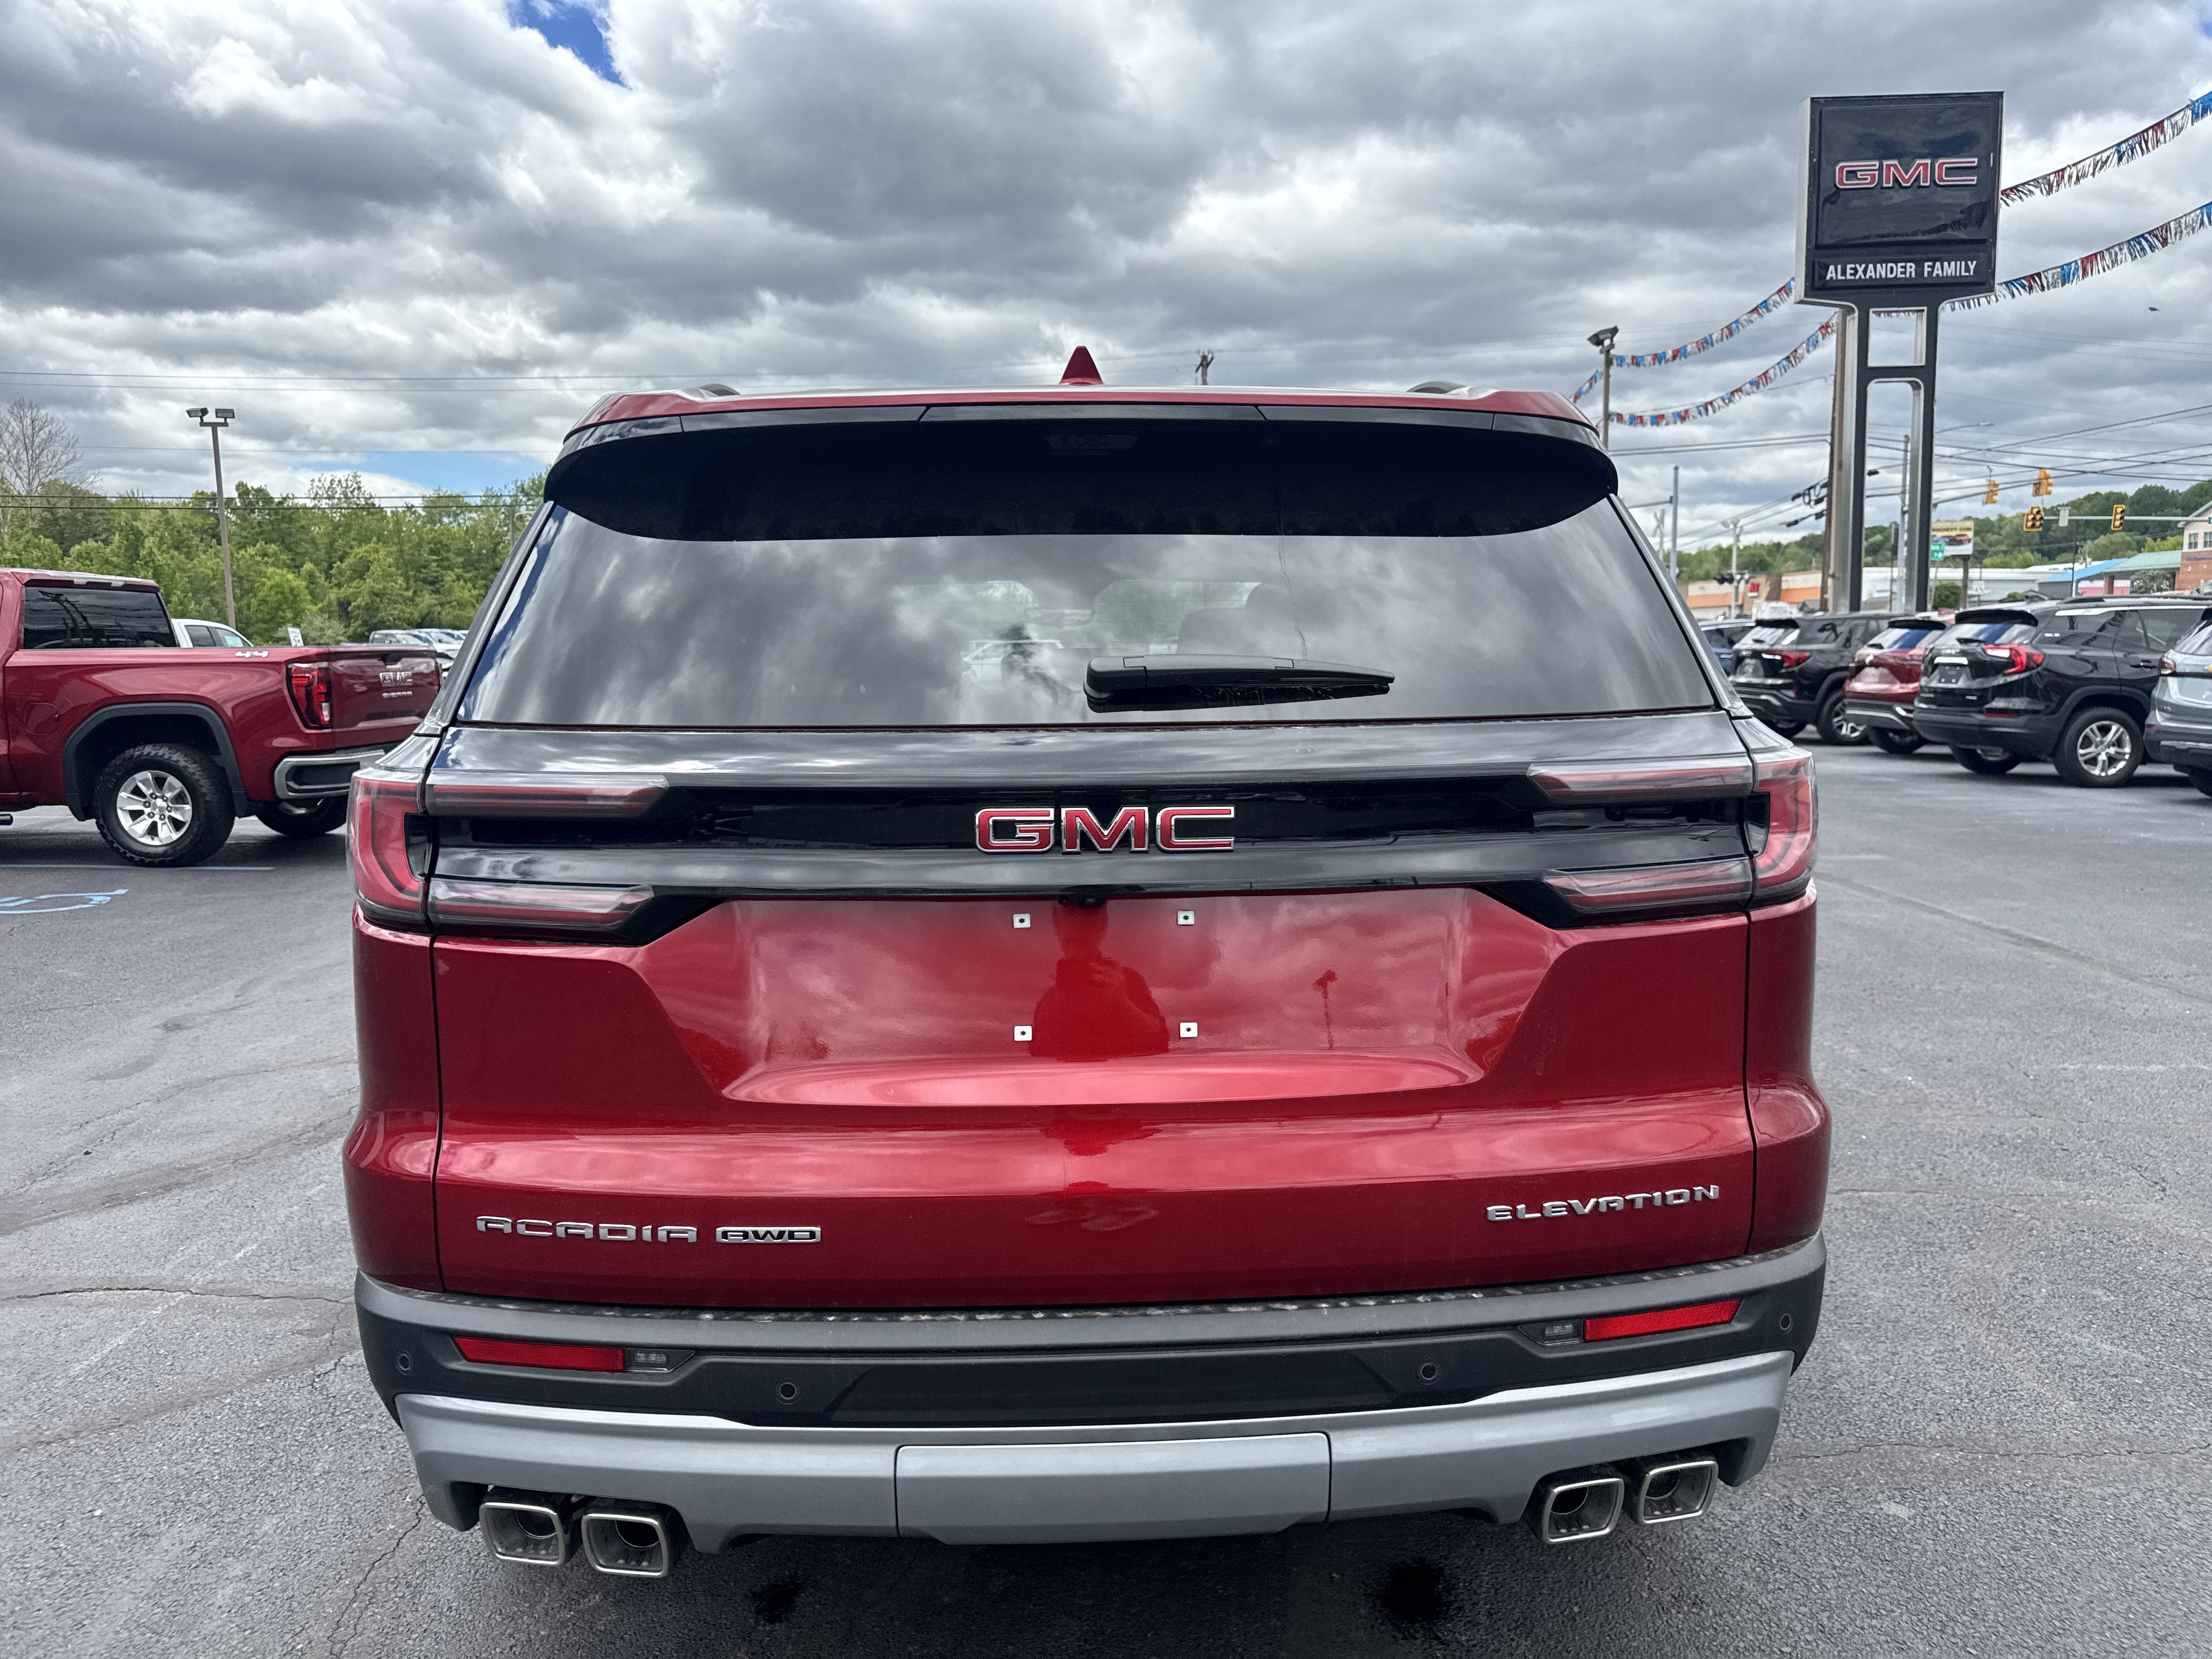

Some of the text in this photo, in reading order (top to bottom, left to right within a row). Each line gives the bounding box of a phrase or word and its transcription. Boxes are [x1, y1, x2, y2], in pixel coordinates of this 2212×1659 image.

[1836, 157, 1978, 189] GMC
[1826, 261, 1977, 280] ALEXANDER FAMILY
[975, 806, 1235, 854] GMC
[1486, 1184, 1719, 1221] ELEVATION
[476, 1215, 817, 1243] ACADIA AWD
